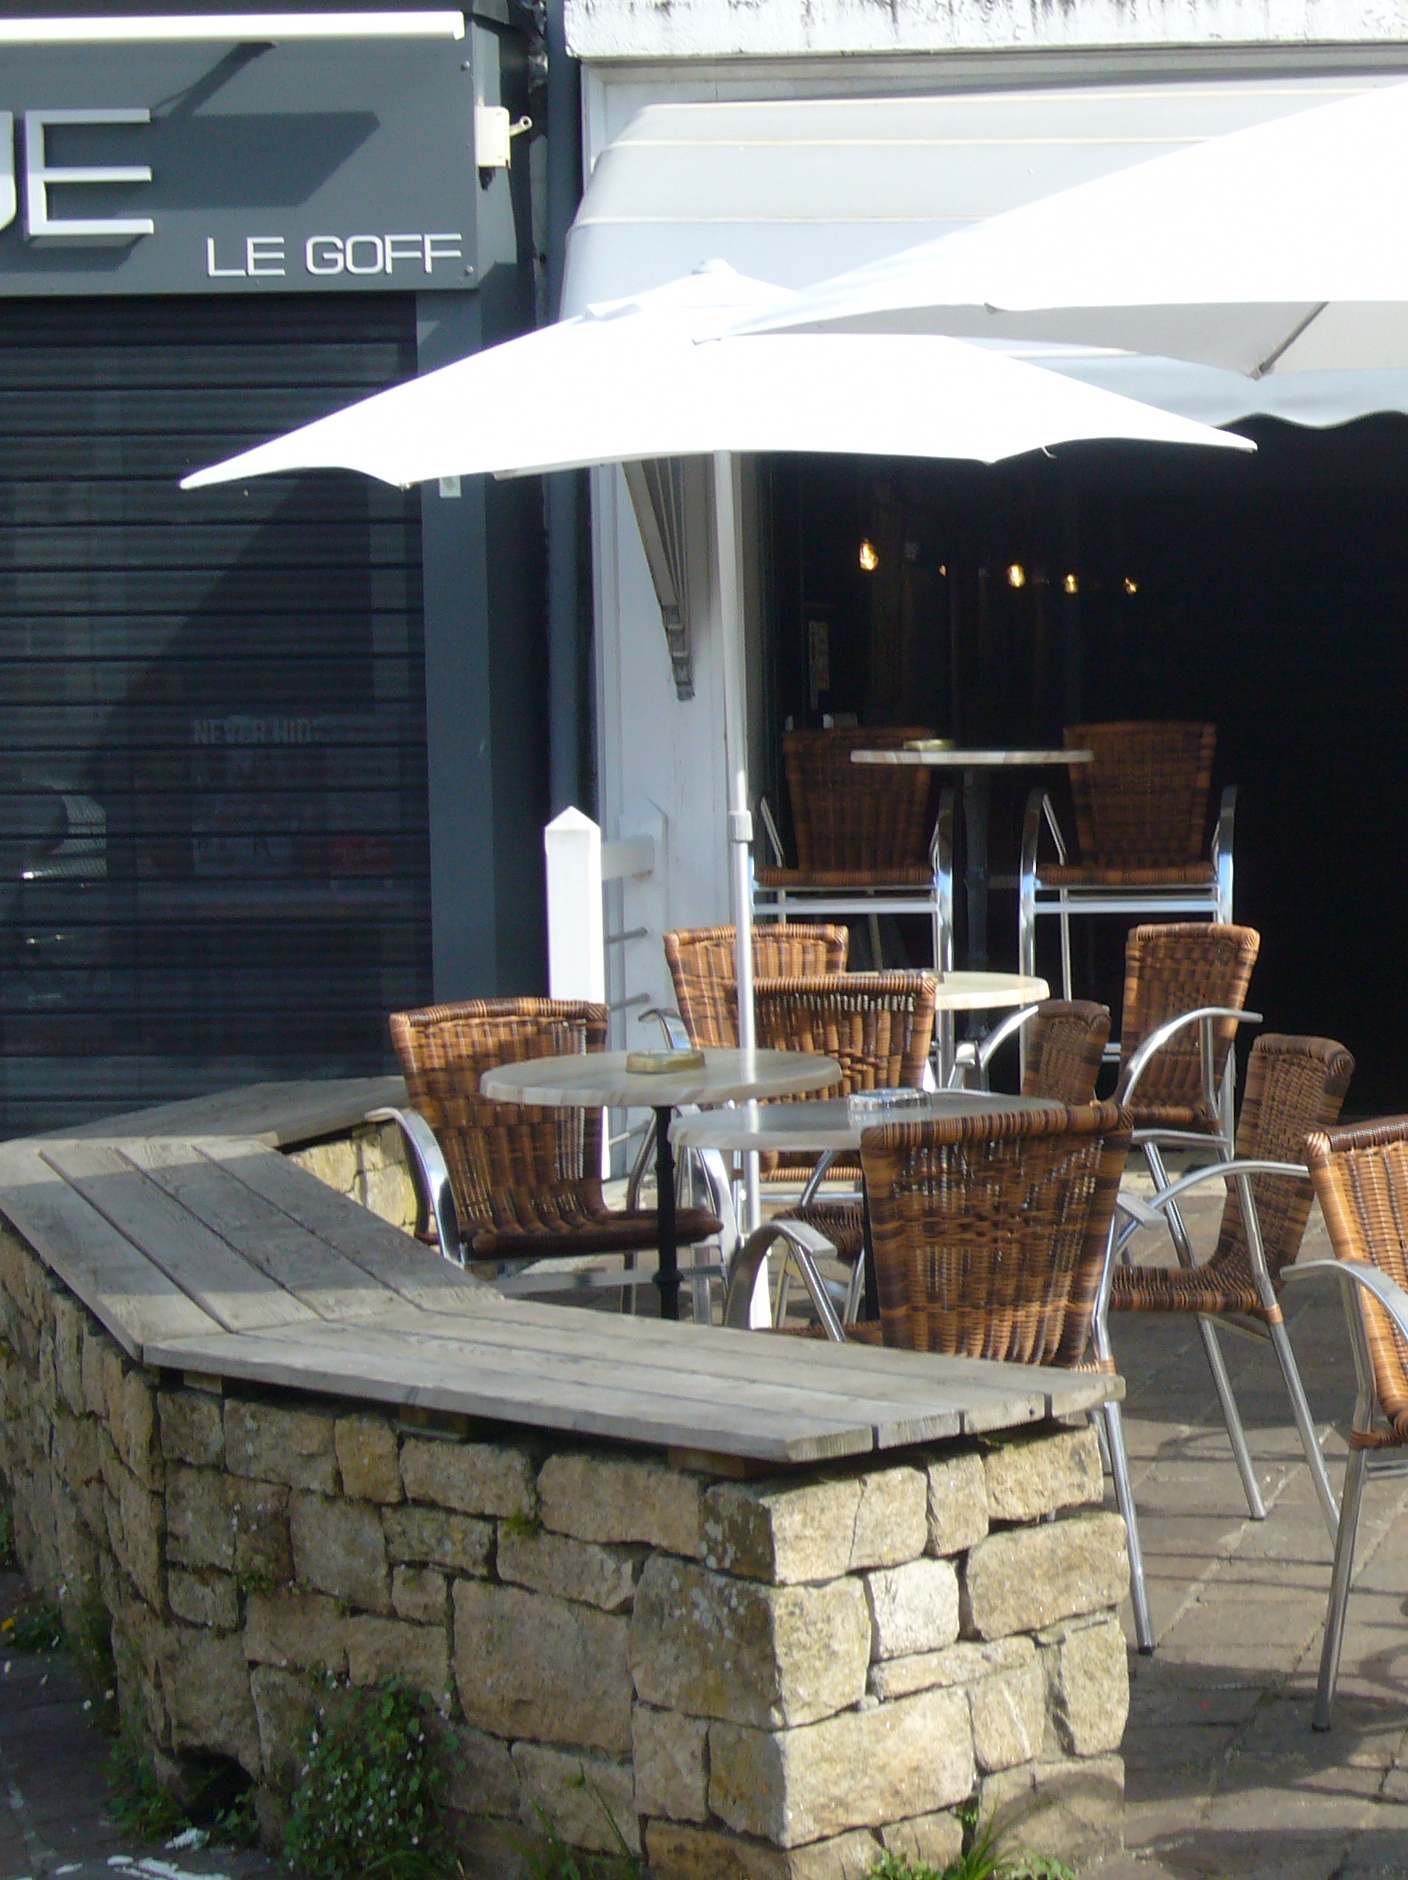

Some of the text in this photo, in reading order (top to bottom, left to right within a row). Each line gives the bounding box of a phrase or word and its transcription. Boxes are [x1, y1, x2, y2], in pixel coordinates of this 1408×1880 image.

[0, 108, 154, 236] E
[206, 232, 463, 277] LE GOFF
